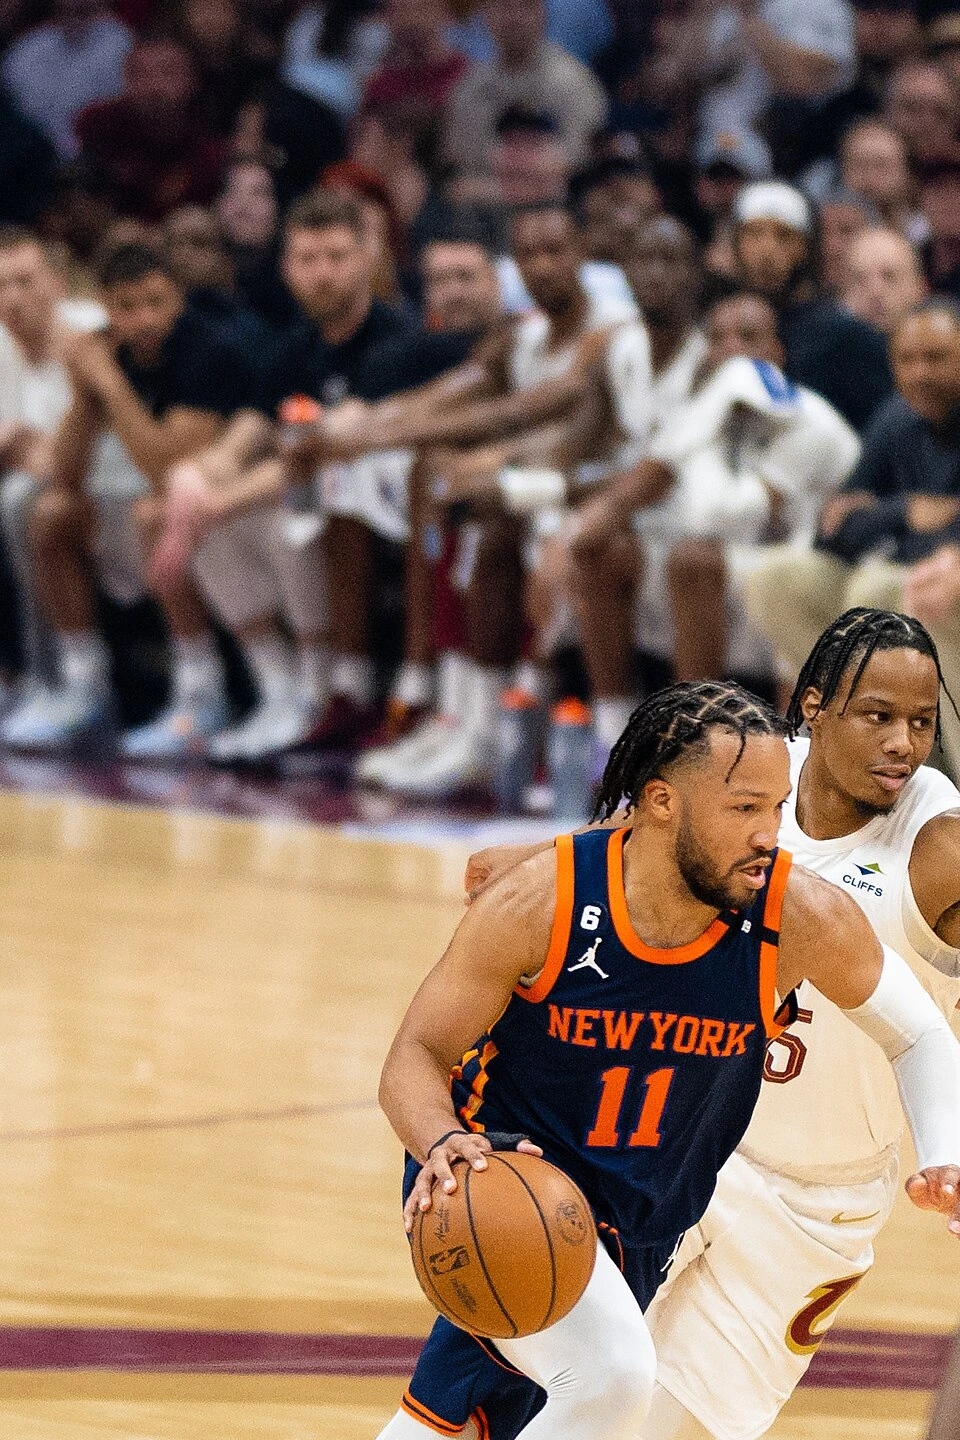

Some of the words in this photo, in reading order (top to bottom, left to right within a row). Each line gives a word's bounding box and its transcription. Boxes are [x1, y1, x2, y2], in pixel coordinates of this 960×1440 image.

[842, 873, 884, 897] CLIFFS
[580, 904, 602, 931] 6
[548, 1003, 645, 1051] NEW
[649, 1011, 757, 1058] YORK
[586, 1065, 678, 1148] 11
